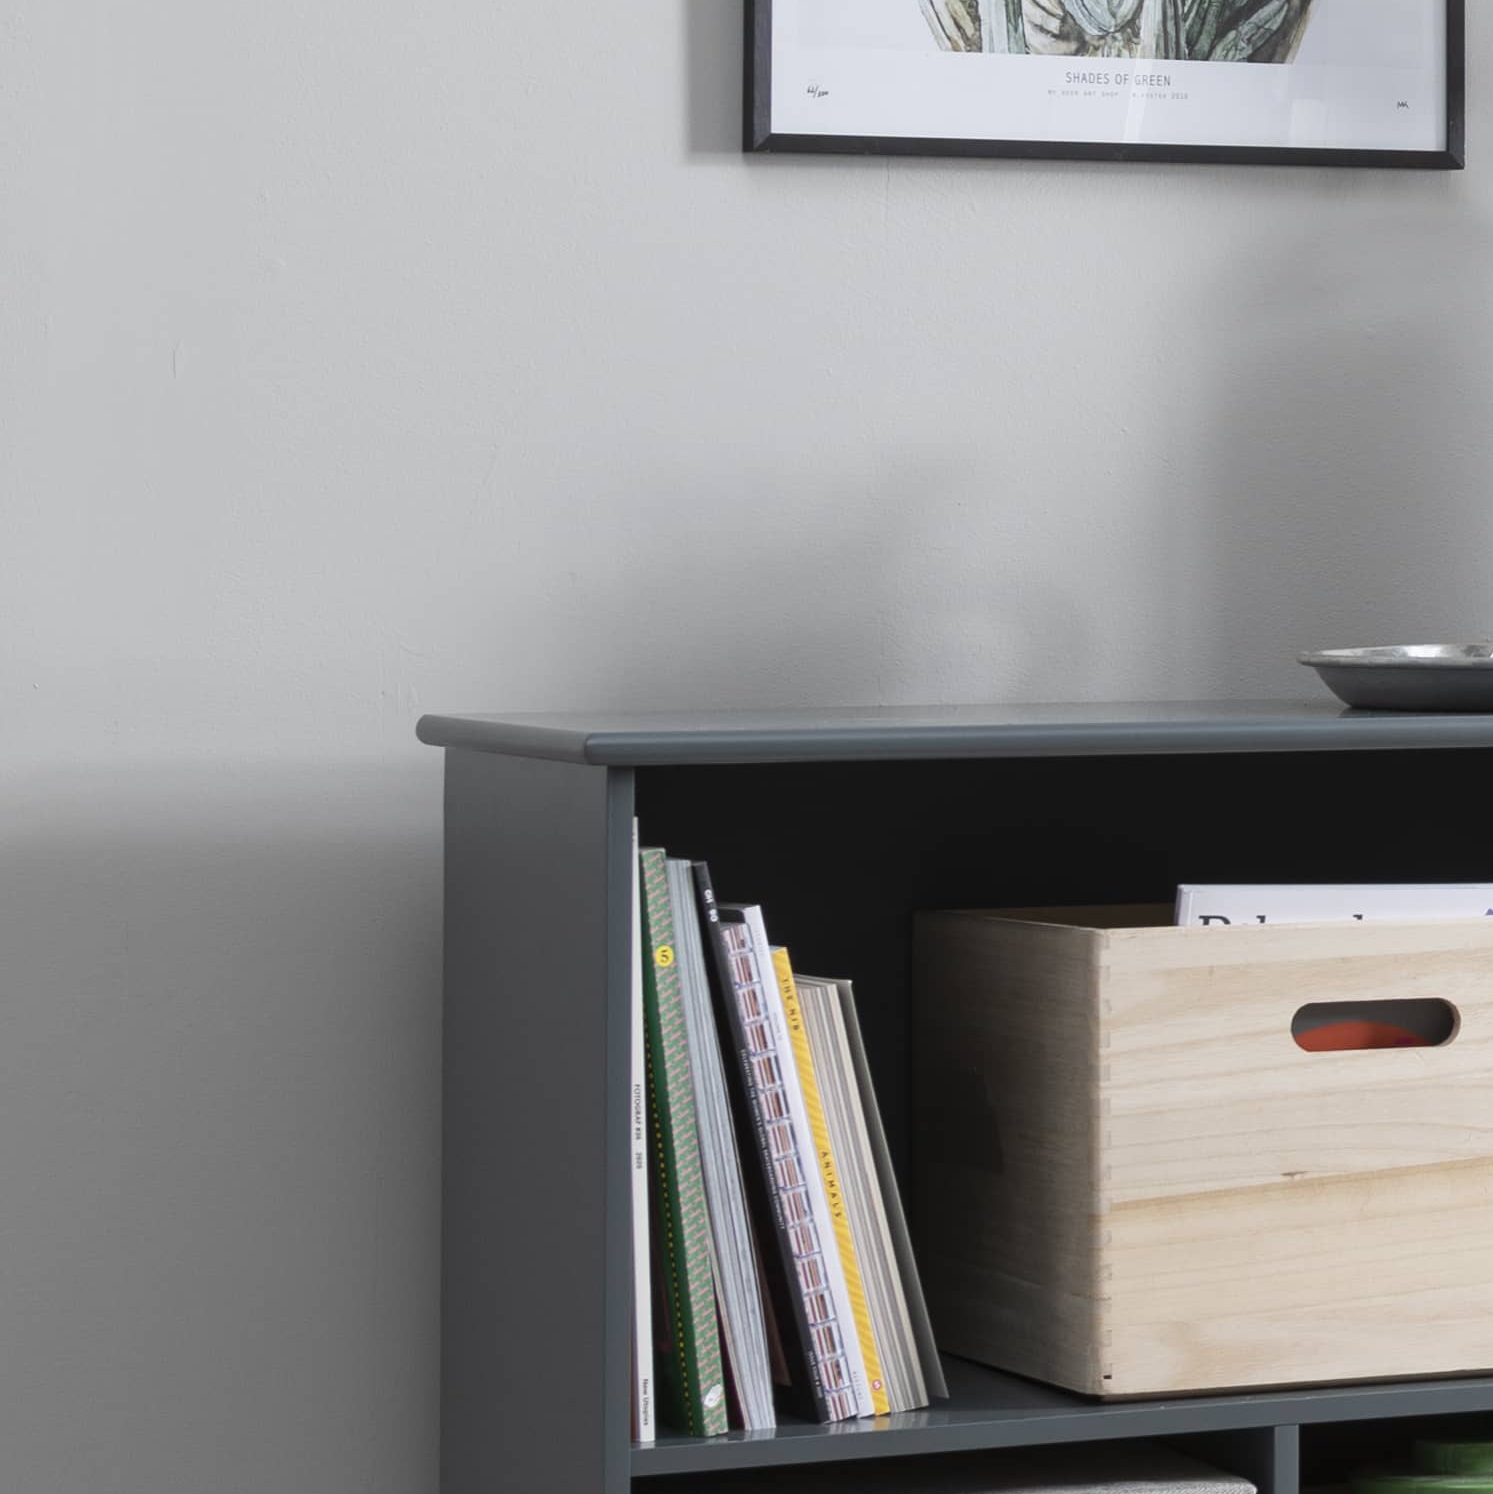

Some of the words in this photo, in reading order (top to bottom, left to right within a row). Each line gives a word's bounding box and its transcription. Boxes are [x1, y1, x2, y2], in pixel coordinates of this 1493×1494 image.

[1065, 71, 1110, 85] SHADES
[1115, 73, 1129, 85] OF
[1135, 74, 1171, 87] GREEN
[660, 949, 669, 963] 5
[783, 978, 793, 1000] THE
[789, 1008, 800, 1031] NIB
[633, 1083, 641, 1125] FOTOGRAF
[822, 1151, 842, 1218] ANIMALS
